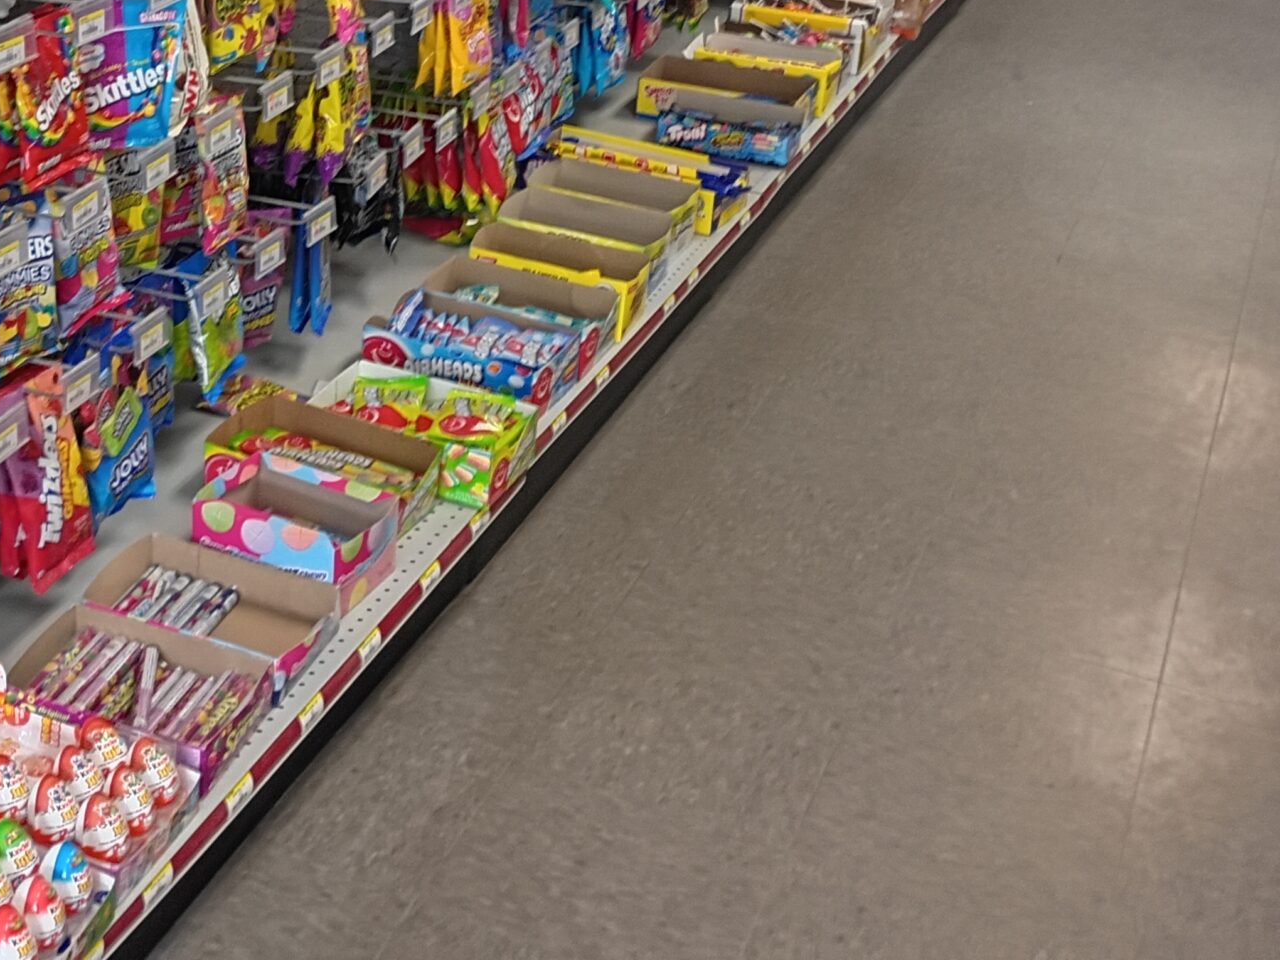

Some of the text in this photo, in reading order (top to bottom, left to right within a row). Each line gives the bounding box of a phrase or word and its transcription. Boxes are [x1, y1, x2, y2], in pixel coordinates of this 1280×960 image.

[84, 62, 167, 114] Skittles
[666, 123, 708, 141] Trolli
[404, 358, 484, 382] AIRHEADS
[110, 432, 150, 490] JOLLY
